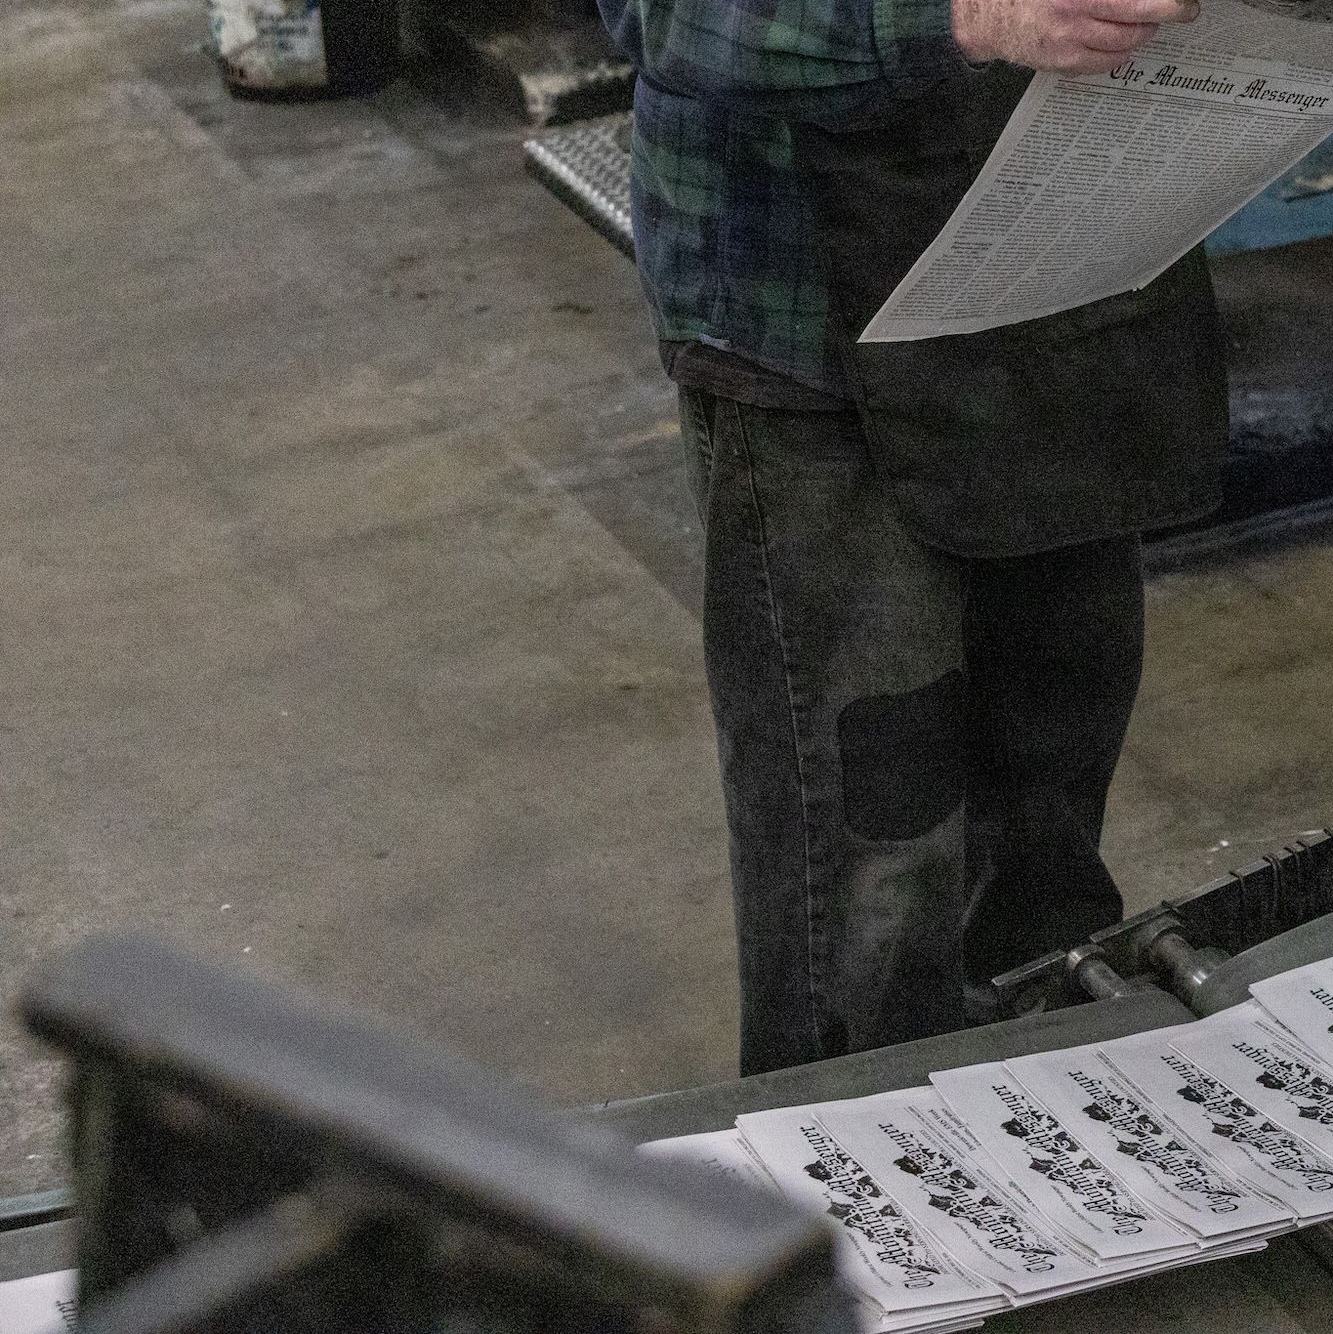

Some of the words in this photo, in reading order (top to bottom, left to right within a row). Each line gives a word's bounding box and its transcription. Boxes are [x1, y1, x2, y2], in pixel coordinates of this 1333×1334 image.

[1111, 61, 1144, 87] The
[1144, 65, 1235, 96] Mountain
[1233, 78, 1330, 111] Messenger
[1066, 1067, 1143, 1128] Messenger
[1161, 1054, 1237, 1116] Messenger
[1232, 1041, 1308, 1098] Messenger
[990, 1081, 1058, 1148] Messenger
[1233, 1111, 1304, 1174] Mountain
[800, 1124, 860, 1197] Messenger
[876, 1119, 956, 1184] Messenger
[1050, 1149, 1117, 1211] Mountain
[1137, 1132, 1209, 1189] Mountain
[850, 1194, 910, 1265] Mountain
[951, 1188, 1029, 1247] Mountain
[1113, 1210, 1142, 1234] The
[1208, 1189, 1239, 1211] The
[901, 1267, 934, 1289] The
[1024, 1247, 1055, 1271] The
